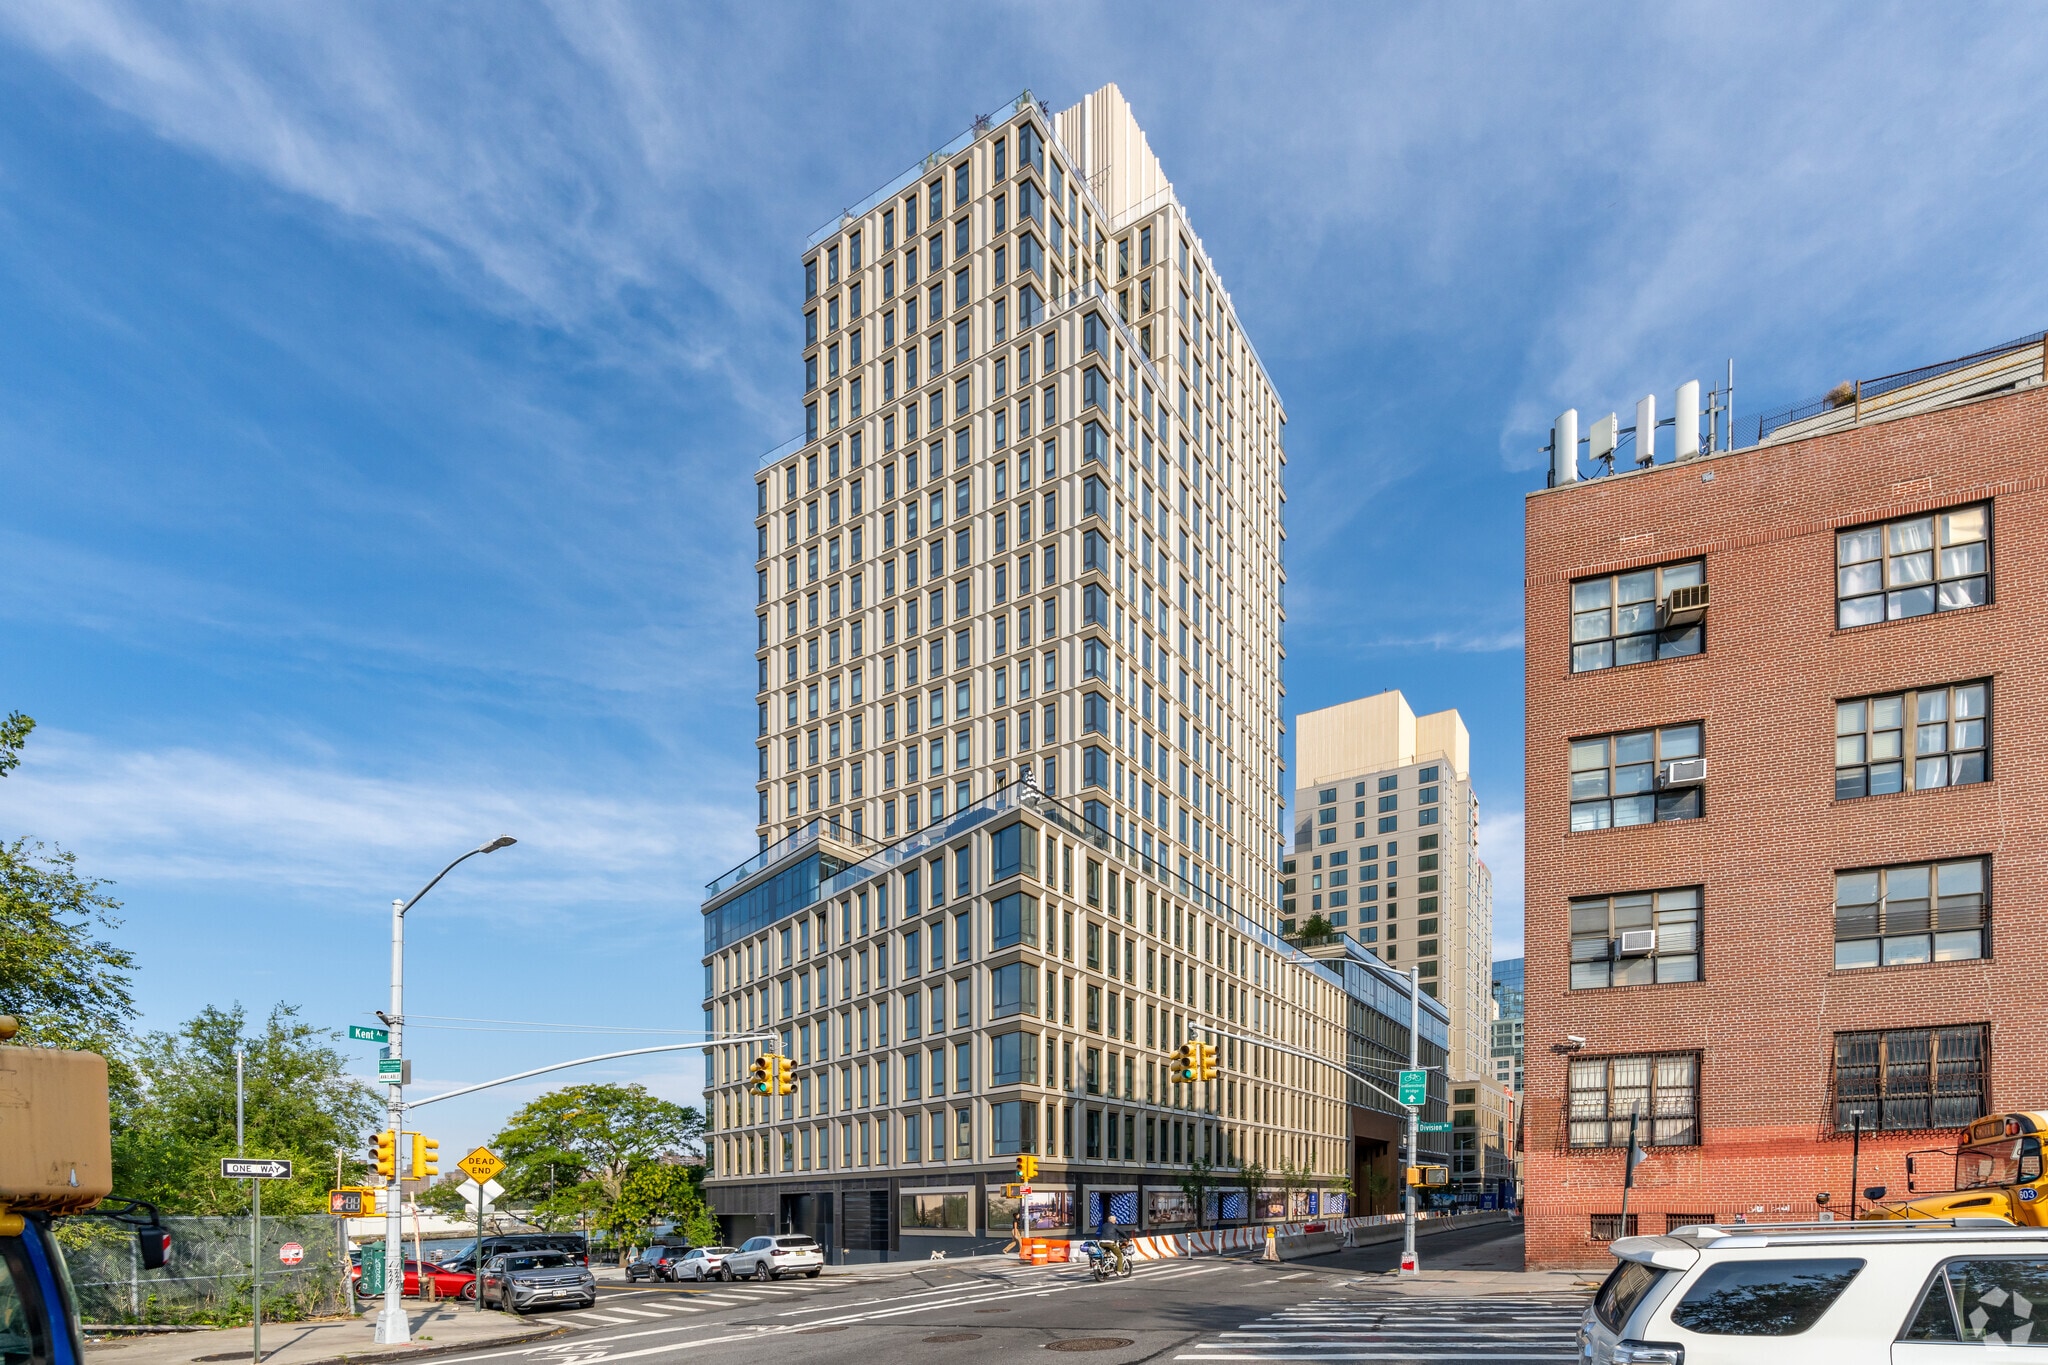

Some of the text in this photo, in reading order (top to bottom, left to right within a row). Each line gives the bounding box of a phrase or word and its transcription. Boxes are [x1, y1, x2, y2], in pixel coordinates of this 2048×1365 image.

[355, 1028, 374, 1040] Kent
[232, 1164, 281, 1173] ONE WAY
[2019, 1190, 2035, 1199] 603
